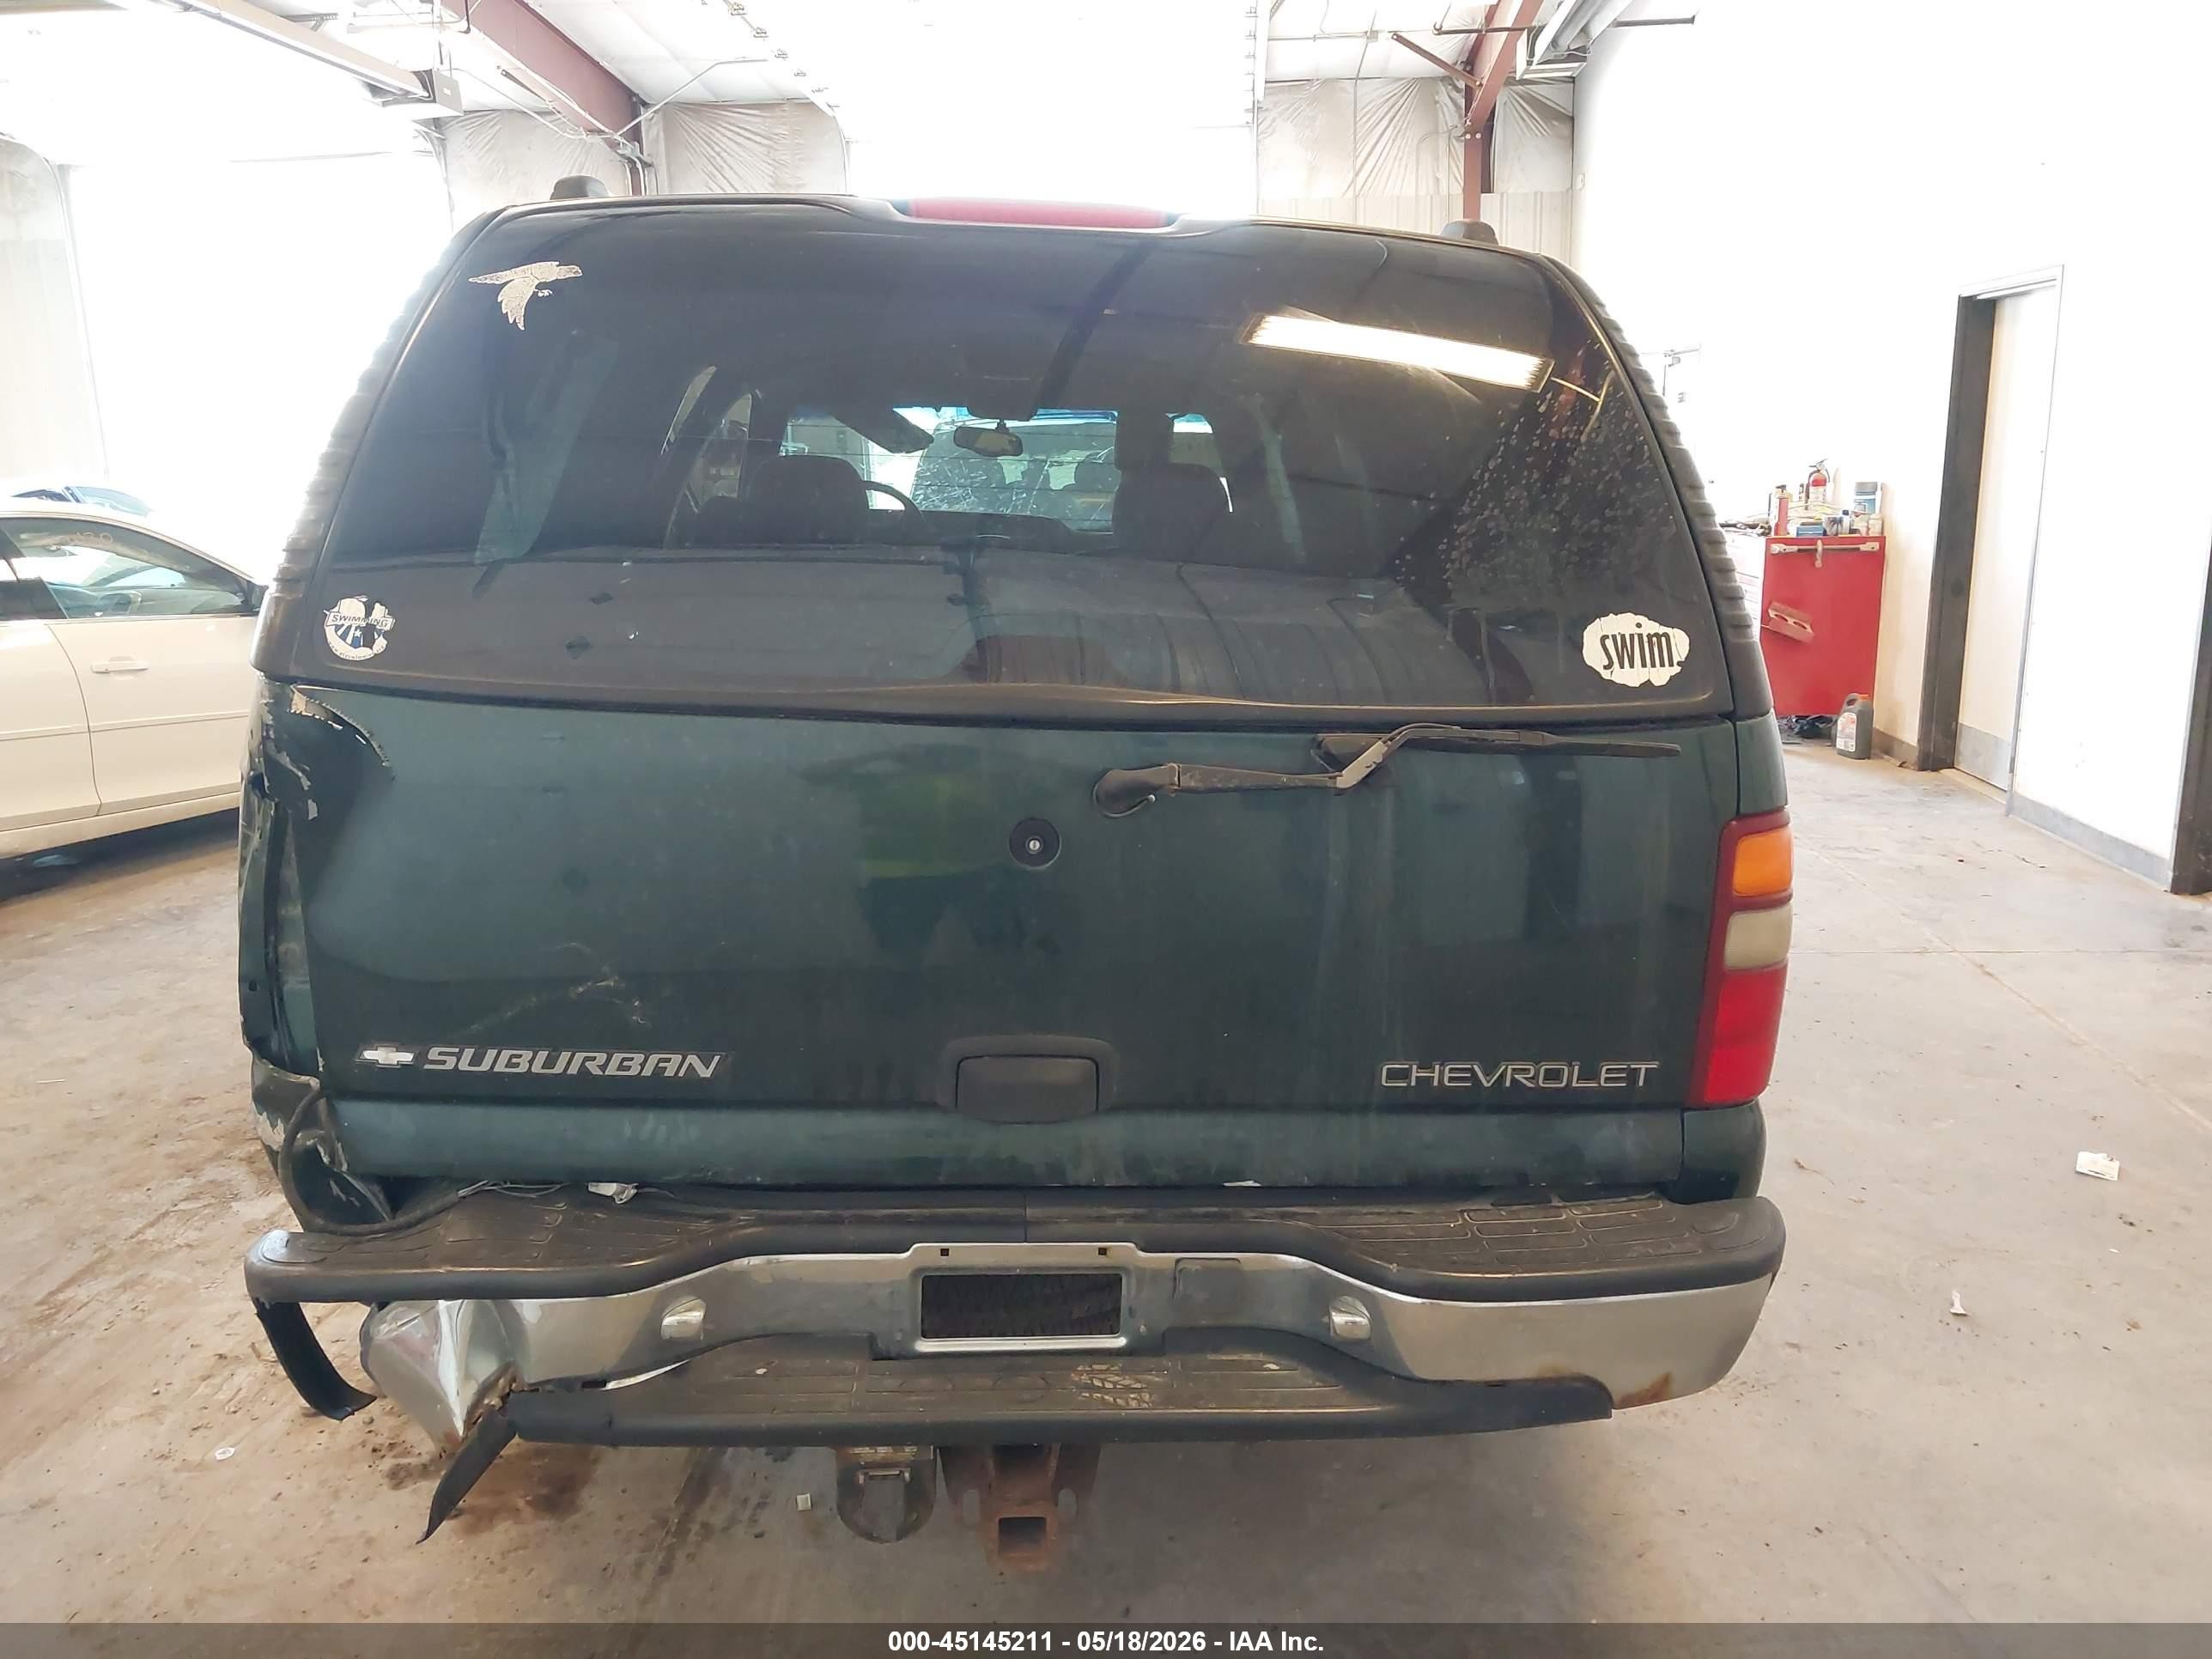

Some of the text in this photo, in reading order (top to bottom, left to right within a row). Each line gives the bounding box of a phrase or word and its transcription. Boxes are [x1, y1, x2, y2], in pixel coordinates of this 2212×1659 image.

[1600, 622, 1674, 670] swim
[423, 1047, 721, 1079] SUBURBAN
[1381, 1061, 1659, 1087] CHEVROLET
